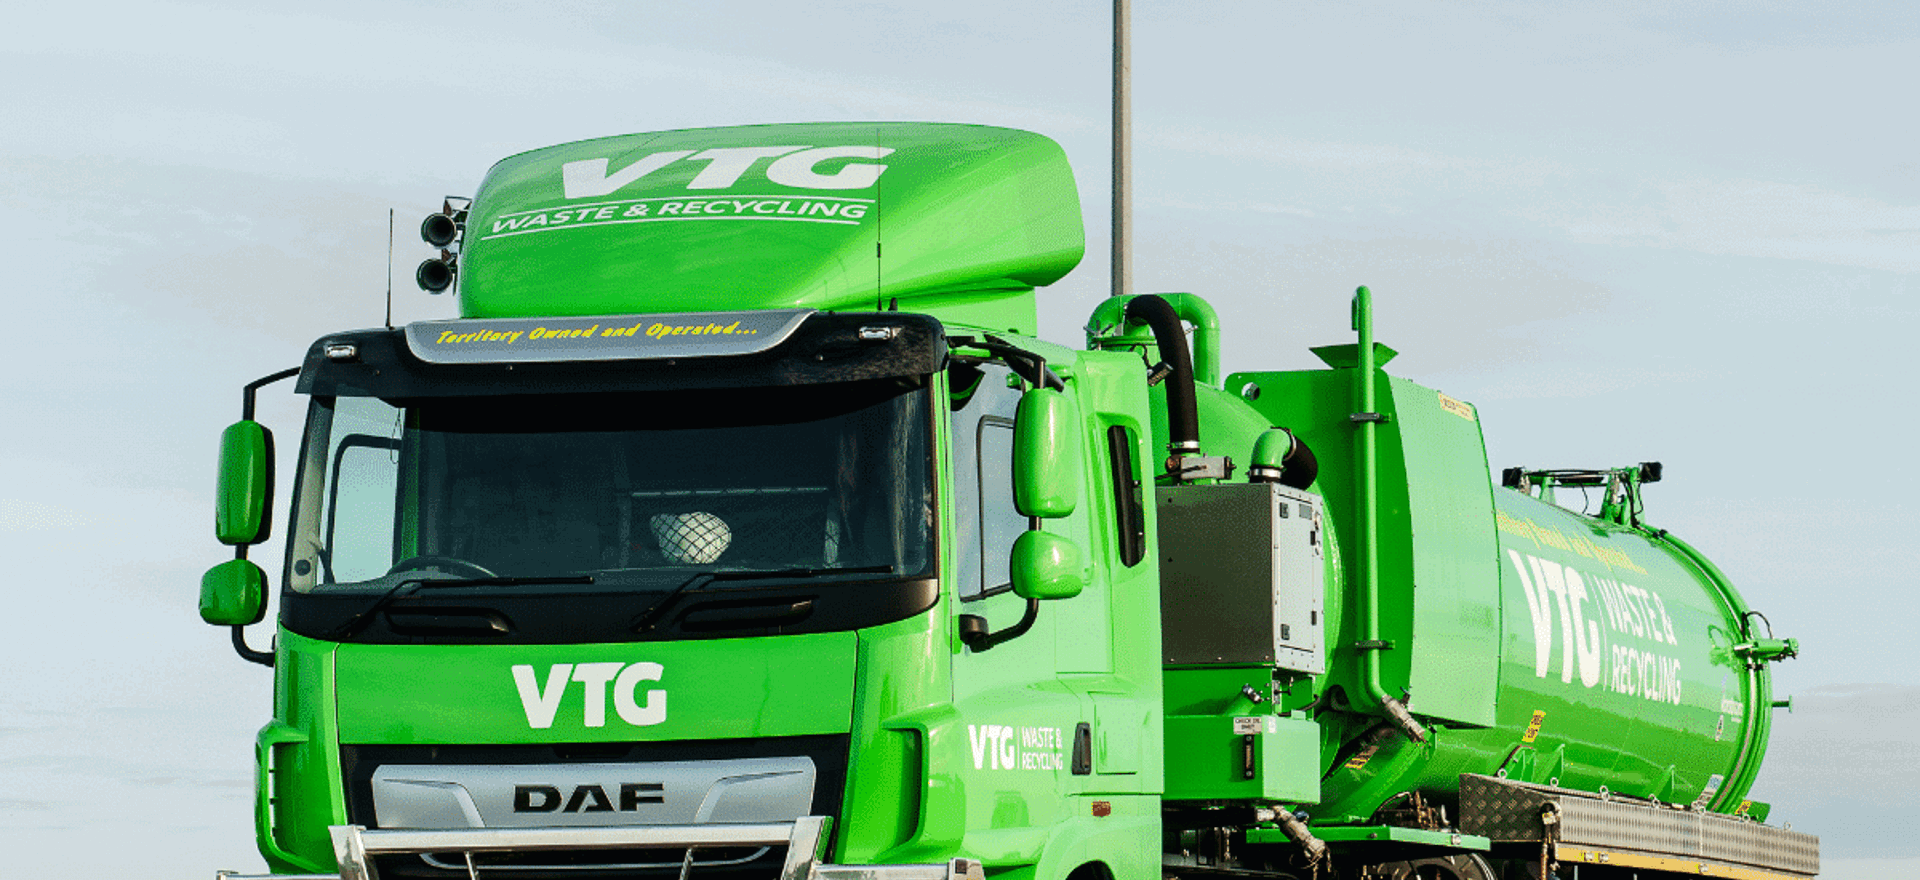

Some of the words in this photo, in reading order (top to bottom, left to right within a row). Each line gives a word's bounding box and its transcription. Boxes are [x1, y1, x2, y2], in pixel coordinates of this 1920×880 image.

[562, 146, 896, 199] VTG
[492, 205, 619, 234] WASTE
[623, 203, 650, 217] &
[657, 200, 869, 219] RECYCLING
[436, 329, 524, 345] Territory
[528, 324, 599, 340] Owned
[601, 323, 642, 338] and
[1507, 548, 1600, 688] VTG
[1593, 574, 1663, 643] WASTE
[1652, 591, 1678, 646] &
[511, 662, 667, 729] VTG
[1611, 643, 1681, 706] RECYCLING
[968, 724, 1015, 770] VTG
[1021, 726, 1054, 748] WASTE
[1056, 727, 1063, 749] &
[1022, 752, 1063, 770] RECYCLING
[514, 783, 665, 813] DAF
